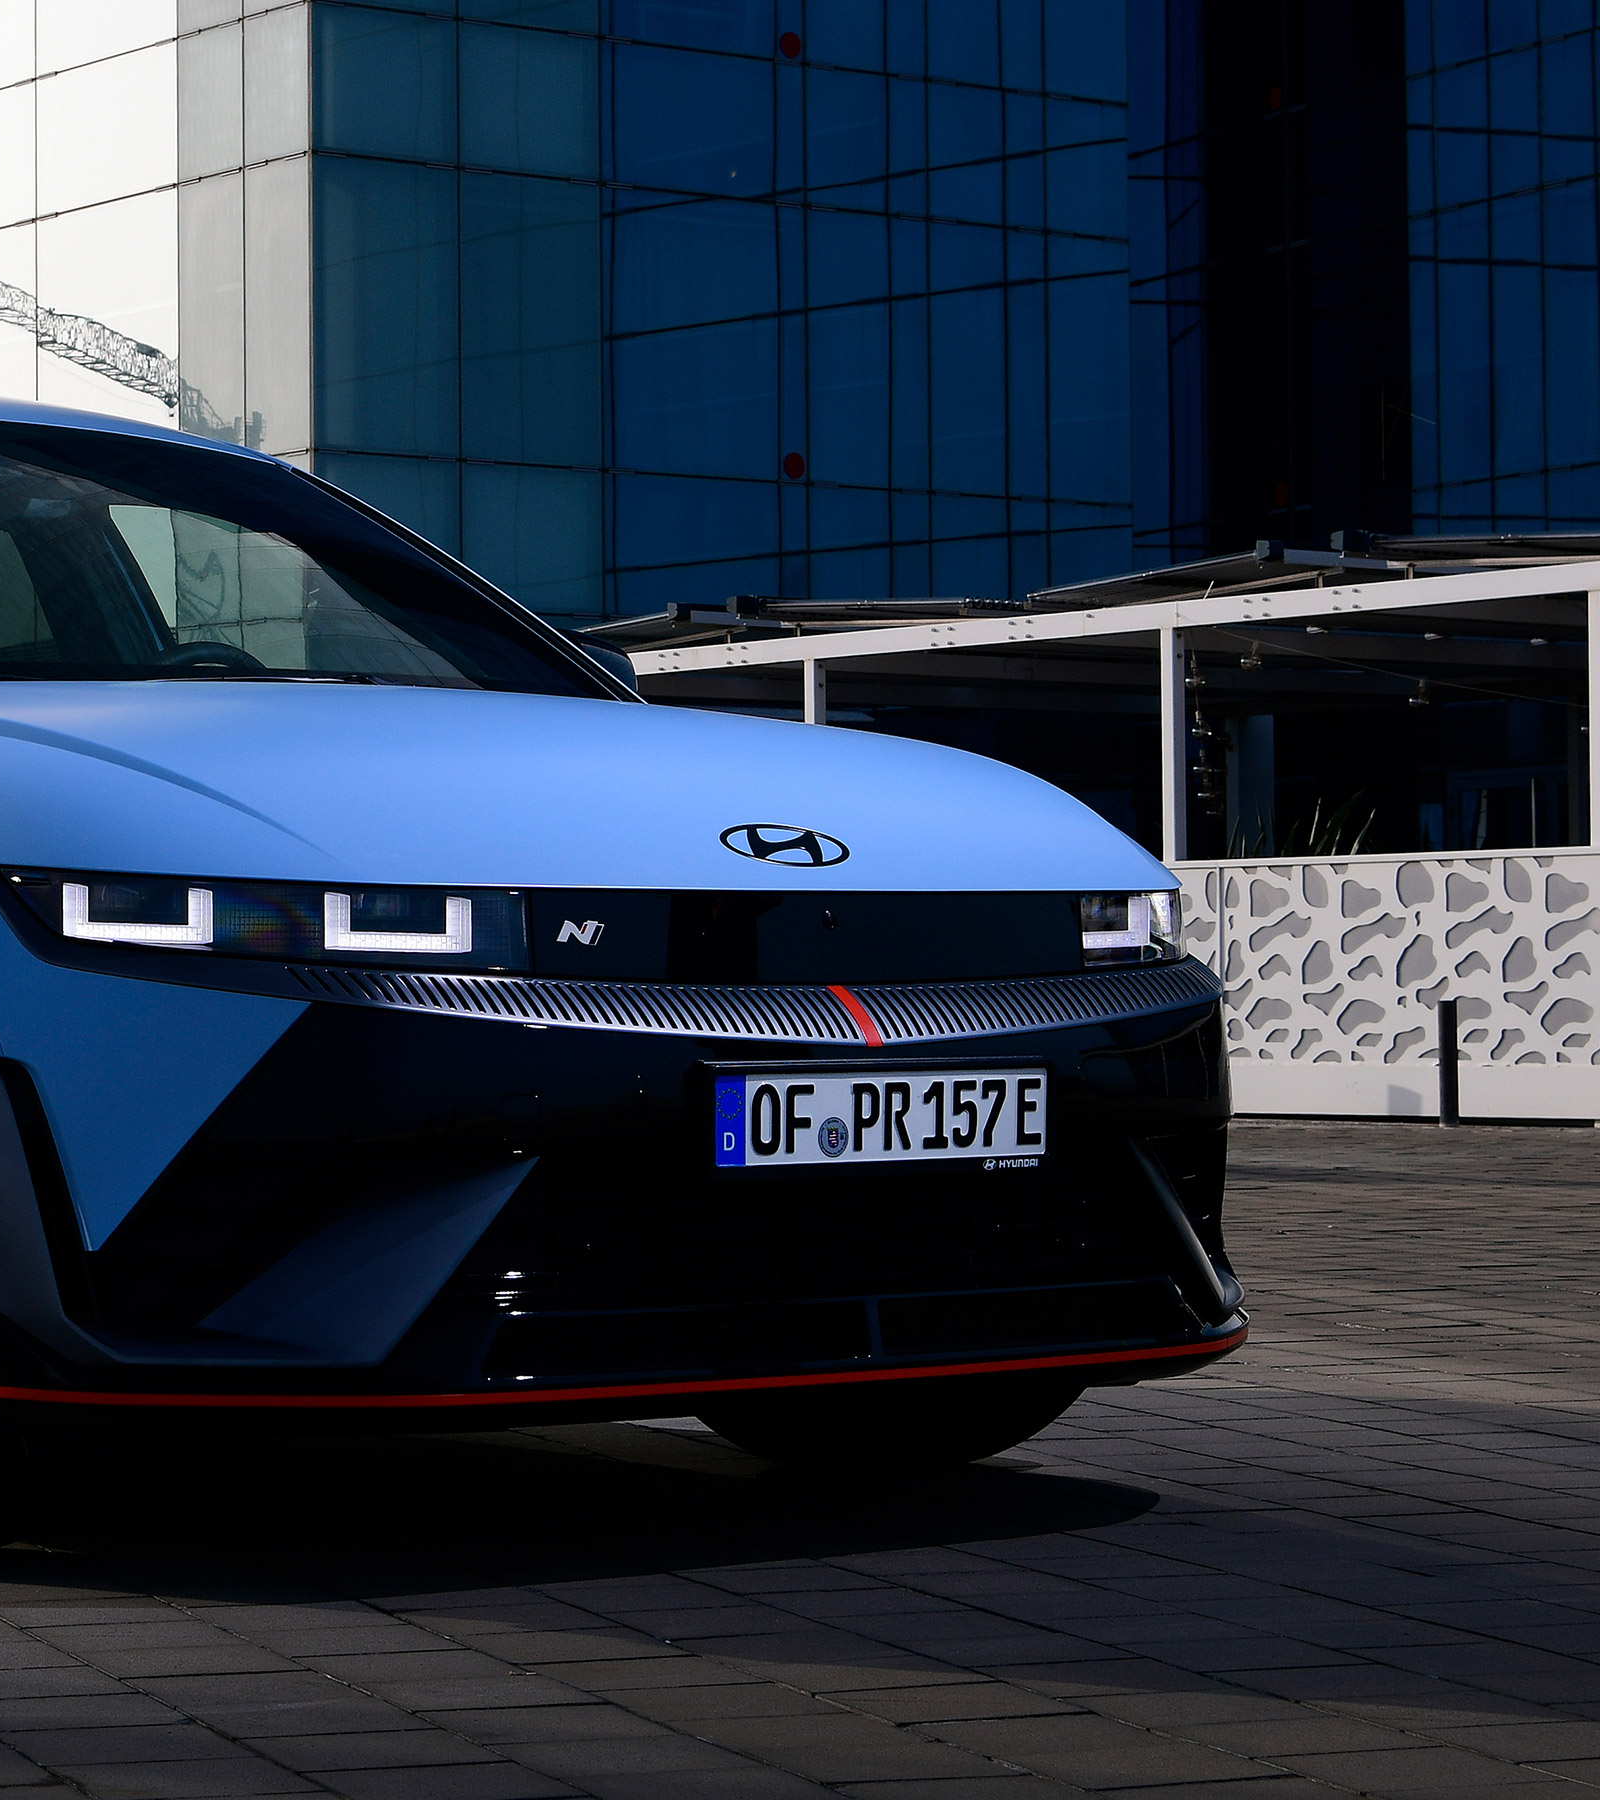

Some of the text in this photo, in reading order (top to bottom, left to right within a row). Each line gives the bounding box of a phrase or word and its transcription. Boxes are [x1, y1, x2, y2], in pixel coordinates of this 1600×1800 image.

[751, 1083, 815, 1156] OF
[852, 1081, 912, 1152] PR
[923, 1078, 1007, 1150] 157
[1016, 1077, 1042, 1146] E
[723, 1132, 735, 1151] D
[998, 1158, 1039, 1168] HYUNDAI
